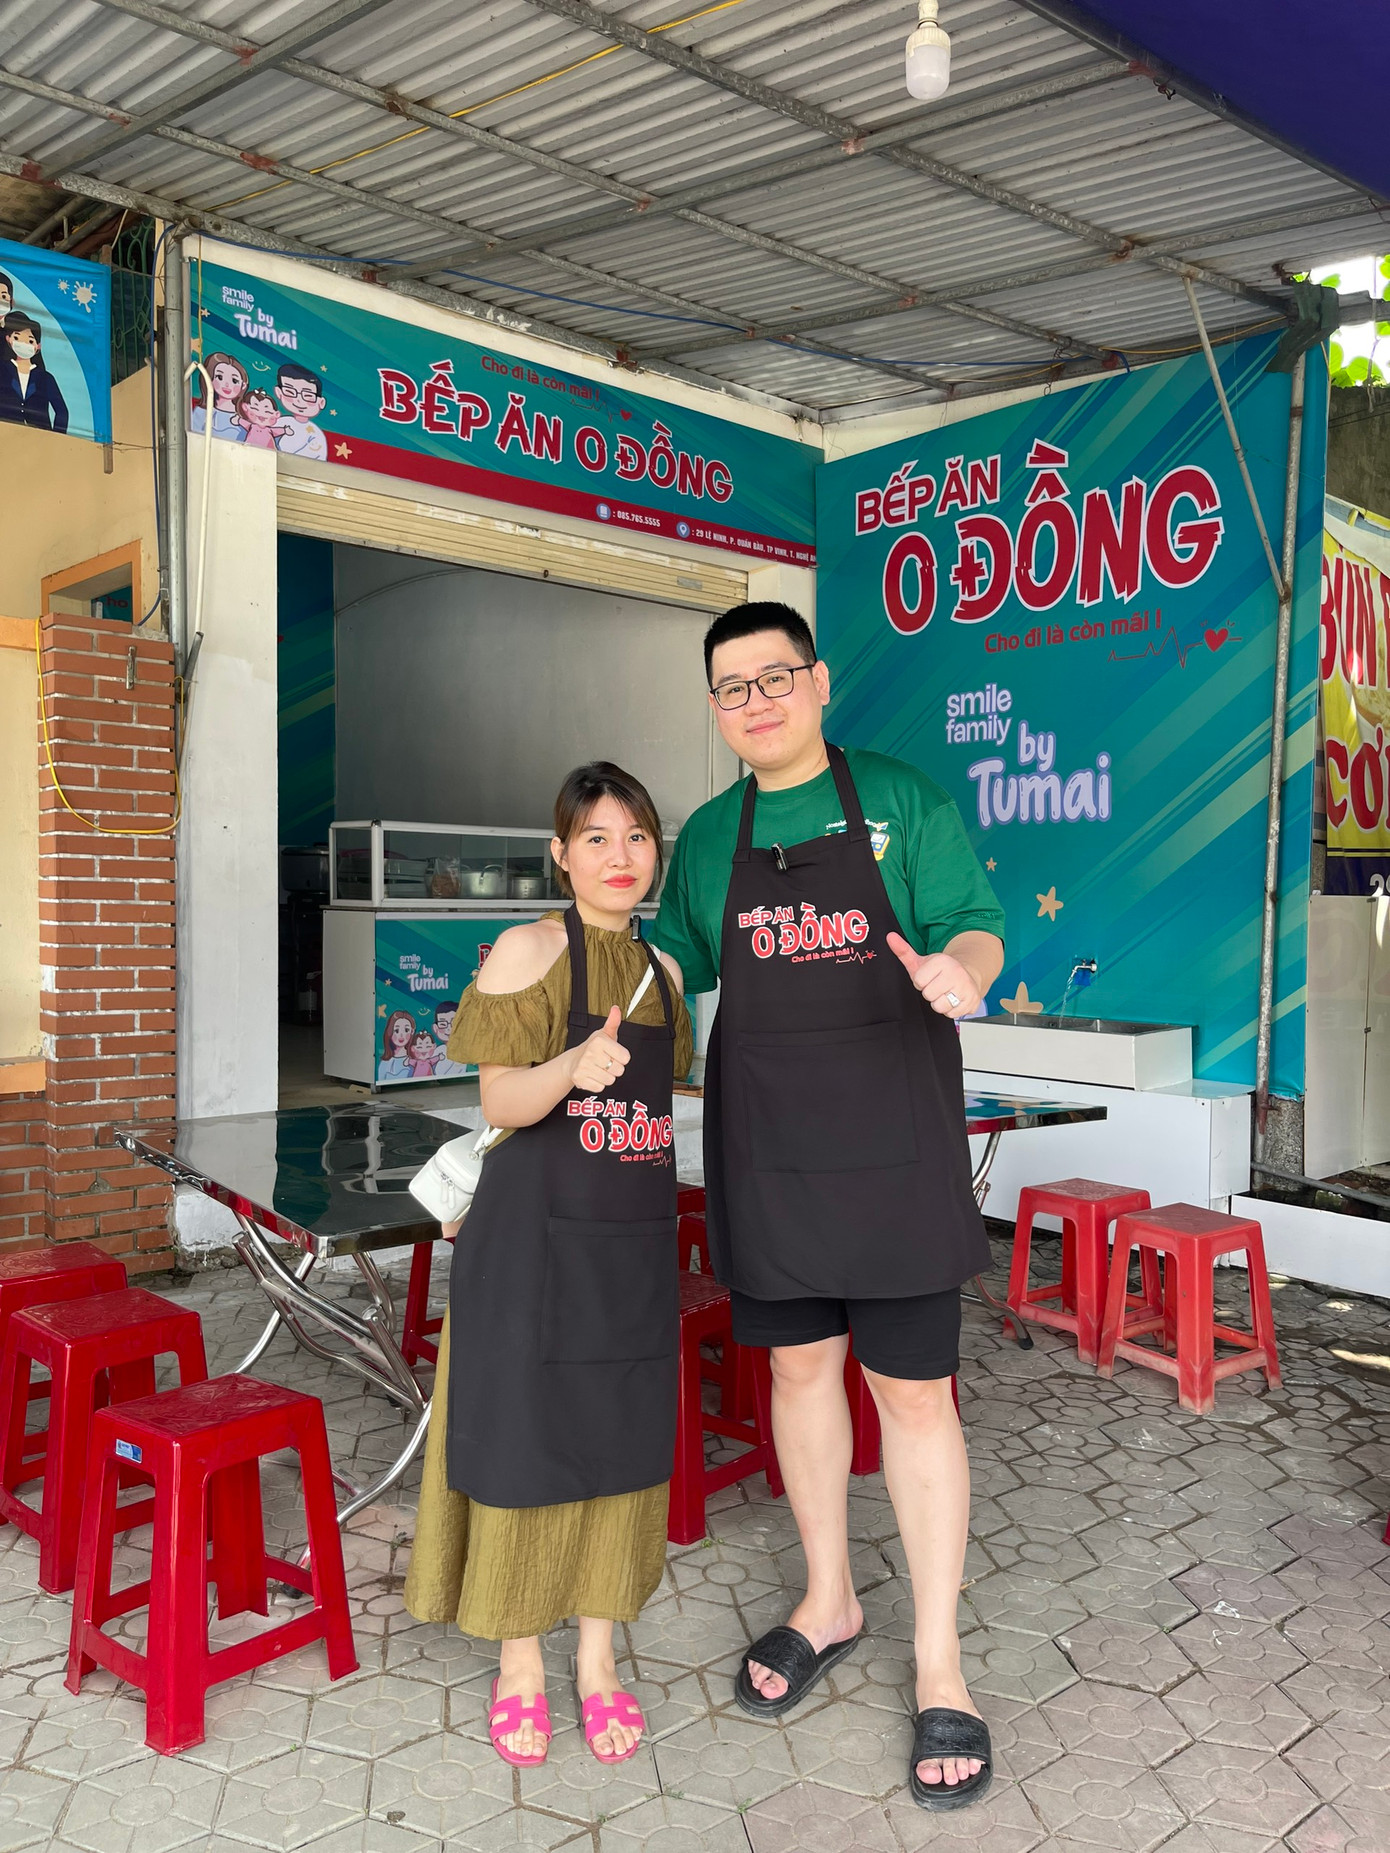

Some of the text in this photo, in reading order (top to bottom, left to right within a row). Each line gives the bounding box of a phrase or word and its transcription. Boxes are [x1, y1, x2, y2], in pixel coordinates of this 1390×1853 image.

[222, 286, 255, 302] smile
[222, 294, 254, 312] family
[233, 313, 298, 350] Tumai
[257, 307, 274, 327] by
[481, 355, 508, 375] Cho
[511, 365, 524, 380] đi
[527, 368, 540, 384] là
[542, 376, 566, 393] còn
[569, 384, 592, 401] mãi
[377, 358, 491, 442] BẾP
[495, 393, 563, 464] ĂN
[615, 420, 734, 503] ĐỒNG
[855, 453, 1001, 537] BẾP ĂN
[617, 510, 661, 527] 085.765.5555
[949, 437, 1226, 625] ĐỒNG
[696, 529, 704, 538] 29
[766, 545, 774, 553] TP
[984, 633, 1020, 654] Cho
[1024, 627, 1042, 648] đi
[1046, 624, 1064, 645] là
[1069, 619, 1105, 642] còn
[946, 682, 1013, 718] smile
[946, 713, 1013, 746] family
[1017, 720, 1056, 772] by
[967, 751, 1112, 830] Tumai
[738, 905, 795, 929] BẾP ĂN
[778, 901, 869, 956] ĐỒNG
[400, 954, 421, 964] smile
[400, 962, 421, 970] family
[422, 964, 434, 977] by
[407, 973, 449, 992] Tumai
[567, 1096, 627, 1118] BẾP ĂN
[608, 1100, 673, 1153] ĐỒNG
